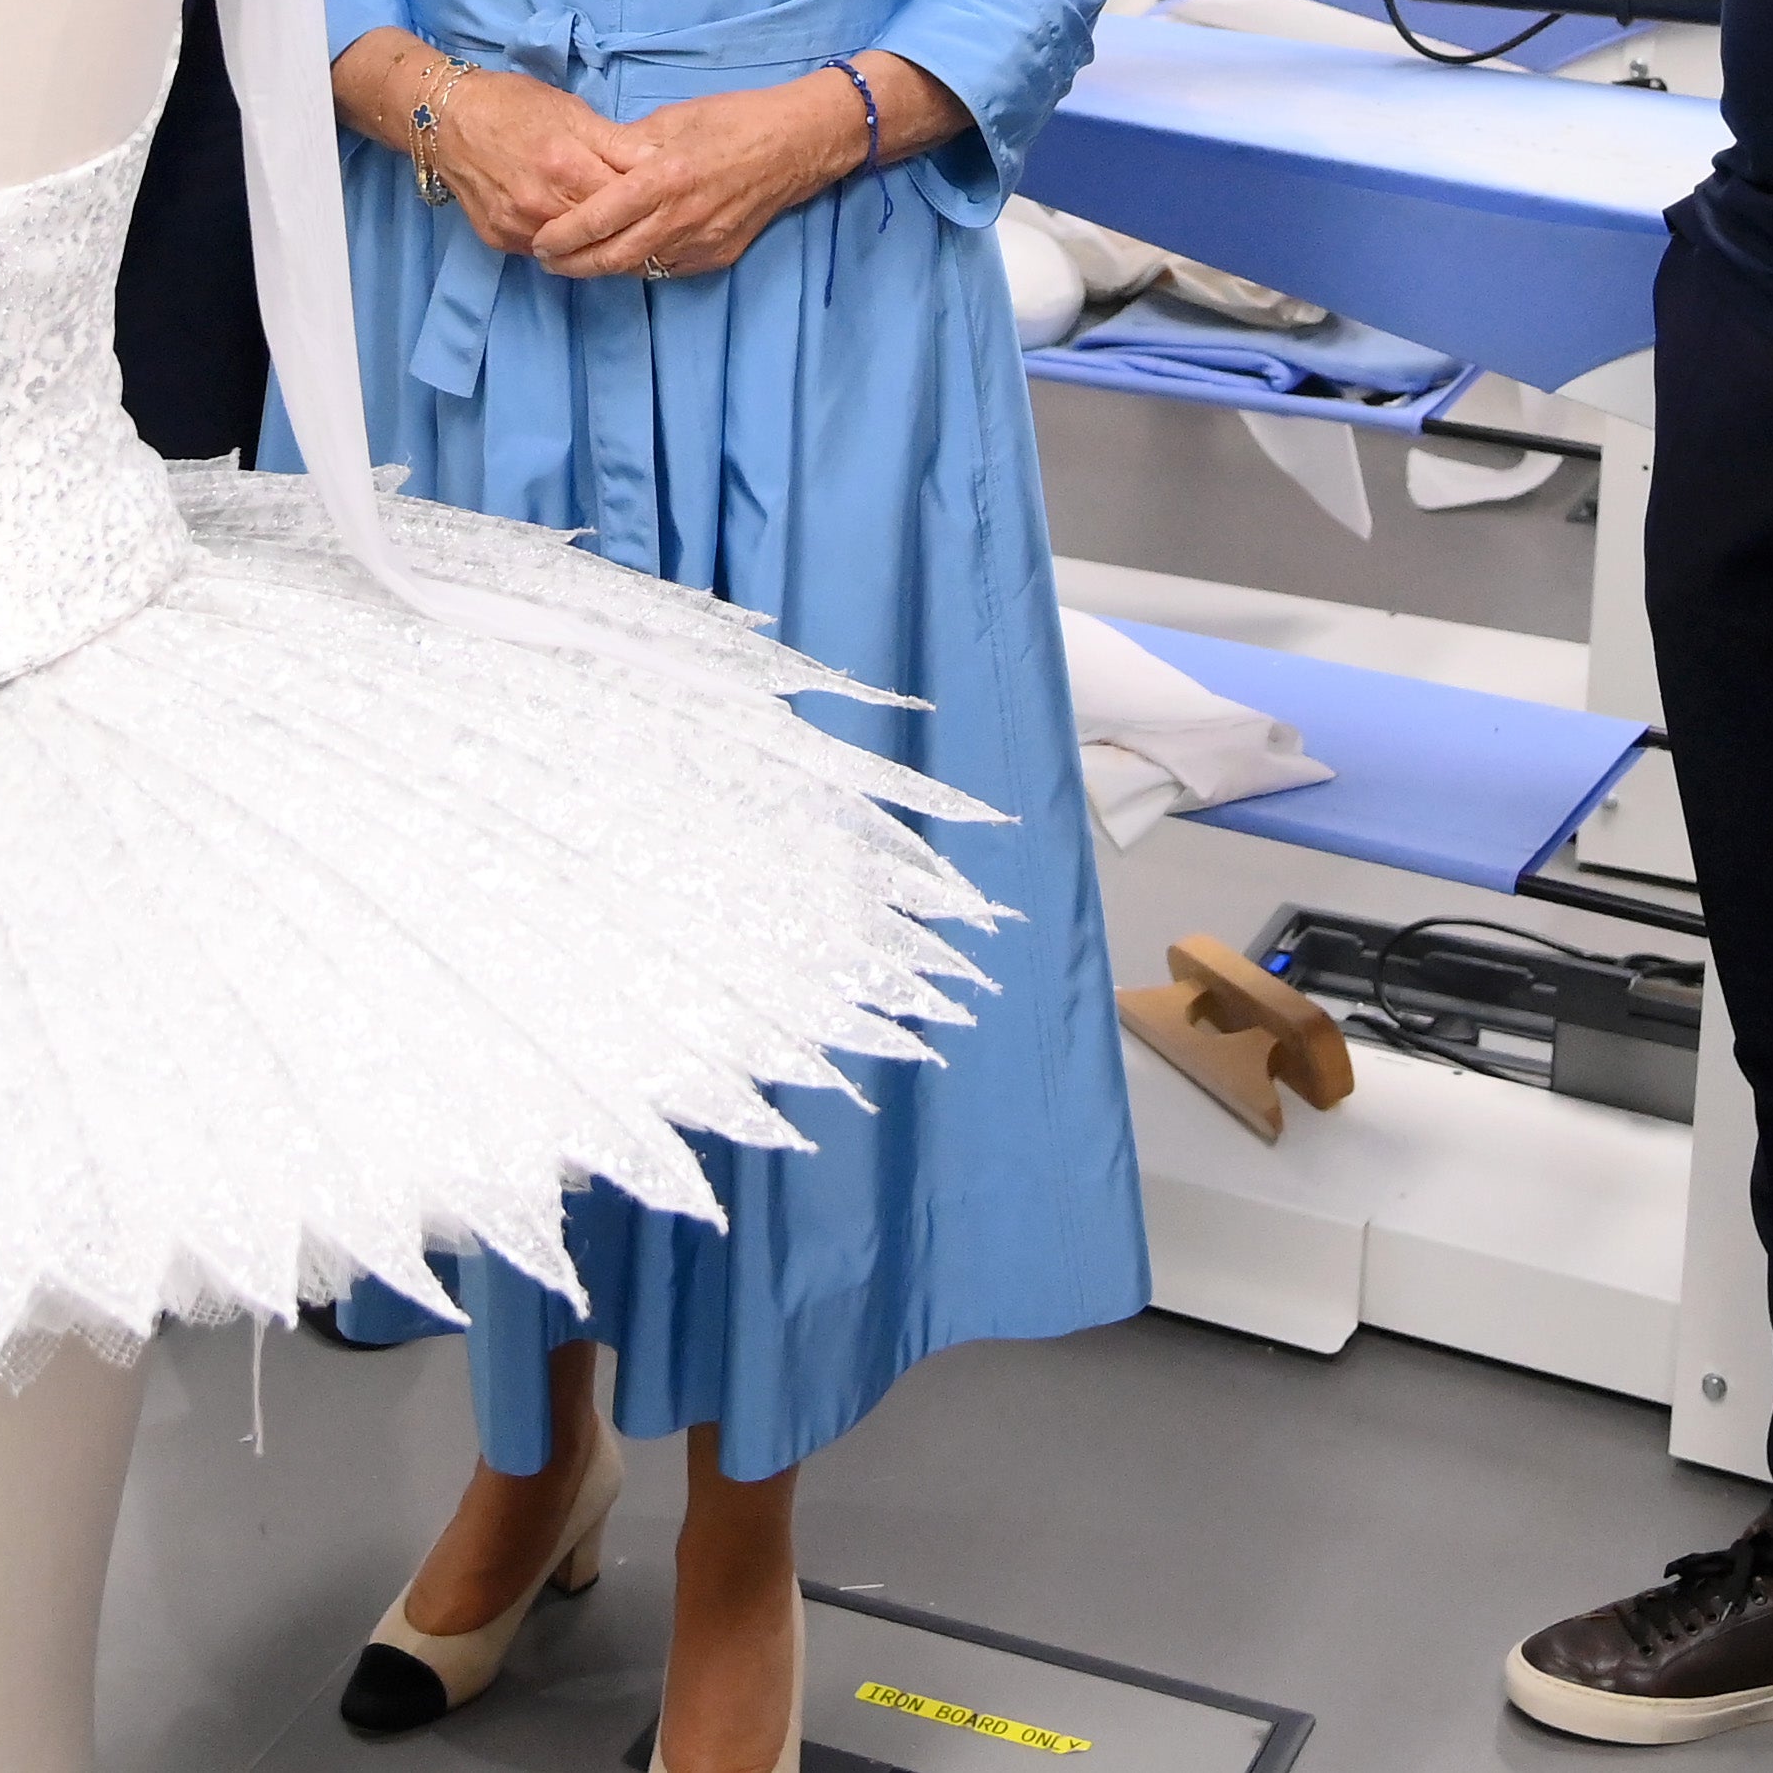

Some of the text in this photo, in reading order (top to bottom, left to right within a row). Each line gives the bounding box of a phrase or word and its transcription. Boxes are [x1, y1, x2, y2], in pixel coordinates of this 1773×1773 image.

[867, 1685, 1082, 1752] IRON BOARD ONLY
